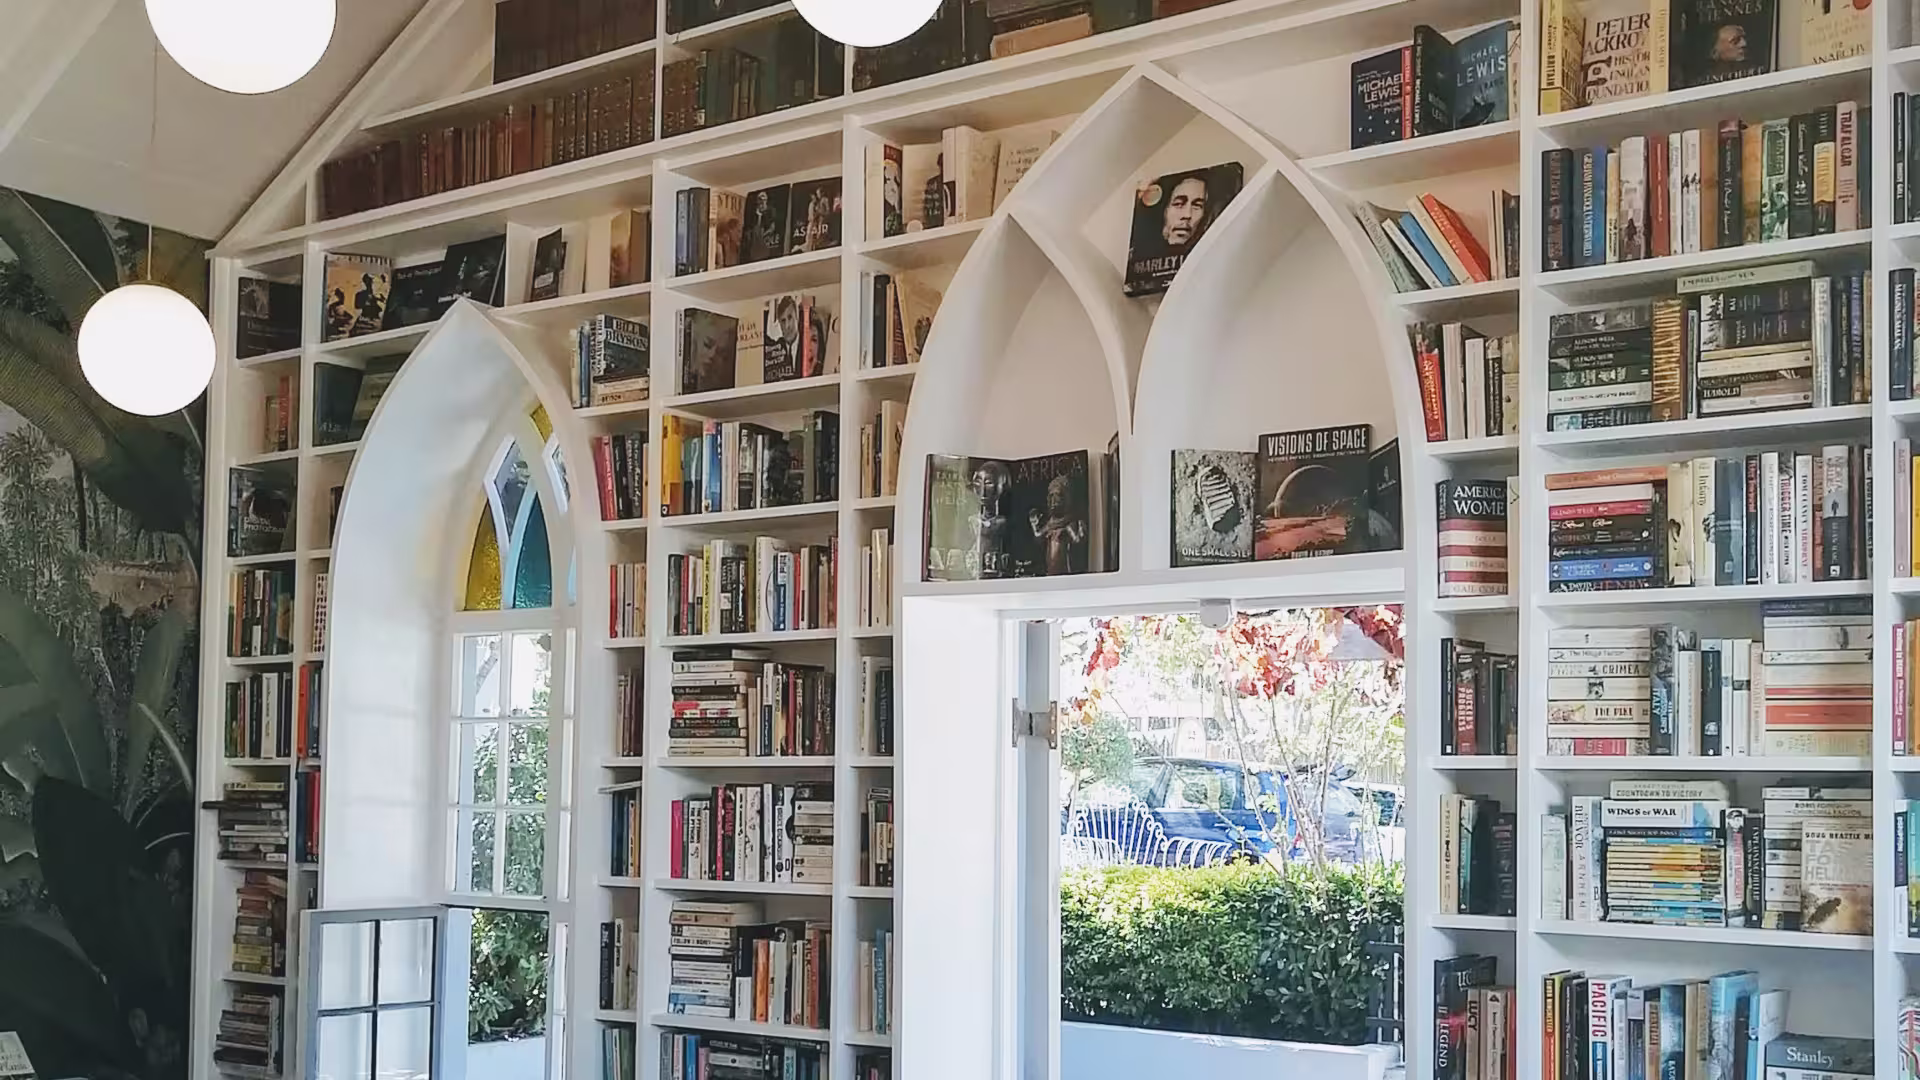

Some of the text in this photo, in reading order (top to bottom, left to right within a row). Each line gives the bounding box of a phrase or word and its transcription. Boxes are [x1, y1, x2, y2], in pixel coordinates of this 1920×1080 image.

[1596, 13, 1650, 37] PETER
[1457, 54, 1507, 88] LEWIS
[1364, 85, 1401, 104] LEWIS
[1840, 110, 1852, 168] TRAFALGAR
[605, 329, 647, 351] BRYSON
[1653, 305, 1681, 404] MOUNTBATTEN
[1702, 387, 1740, 399] HAROLD
[1268, 432, 1313, 457] VISIONS
[1315, 430, 1329, 451] OF
[1332, 427, 1367, 450] SPACE
[1017, 457, 1083, 484] AFRICA
[1781, 477, 1792, 513] TRIGGER
[1781, 513, 1792, 534] TIME
[1182, 547, 1200, 557] ONE
[1201, 547, 1230, 558] SMALL
[1602, 664, 1640, 675] CRIMEA
[1458, 687, 1466, 731] PROGRESS
[1607, 808, 1641, 816] WINGS
[1652, 808, 1677, 816] WAR
[1574, 805, 1584, 849] BEEVOR
[1468, 1000, 1478, 1031] LUCY
[1591, 982, 1607, 1038] PACIFIC
[1439, 1023, 1450, 1068] LEGEND
[1786, 1045, 1835, 1067] Stanley
